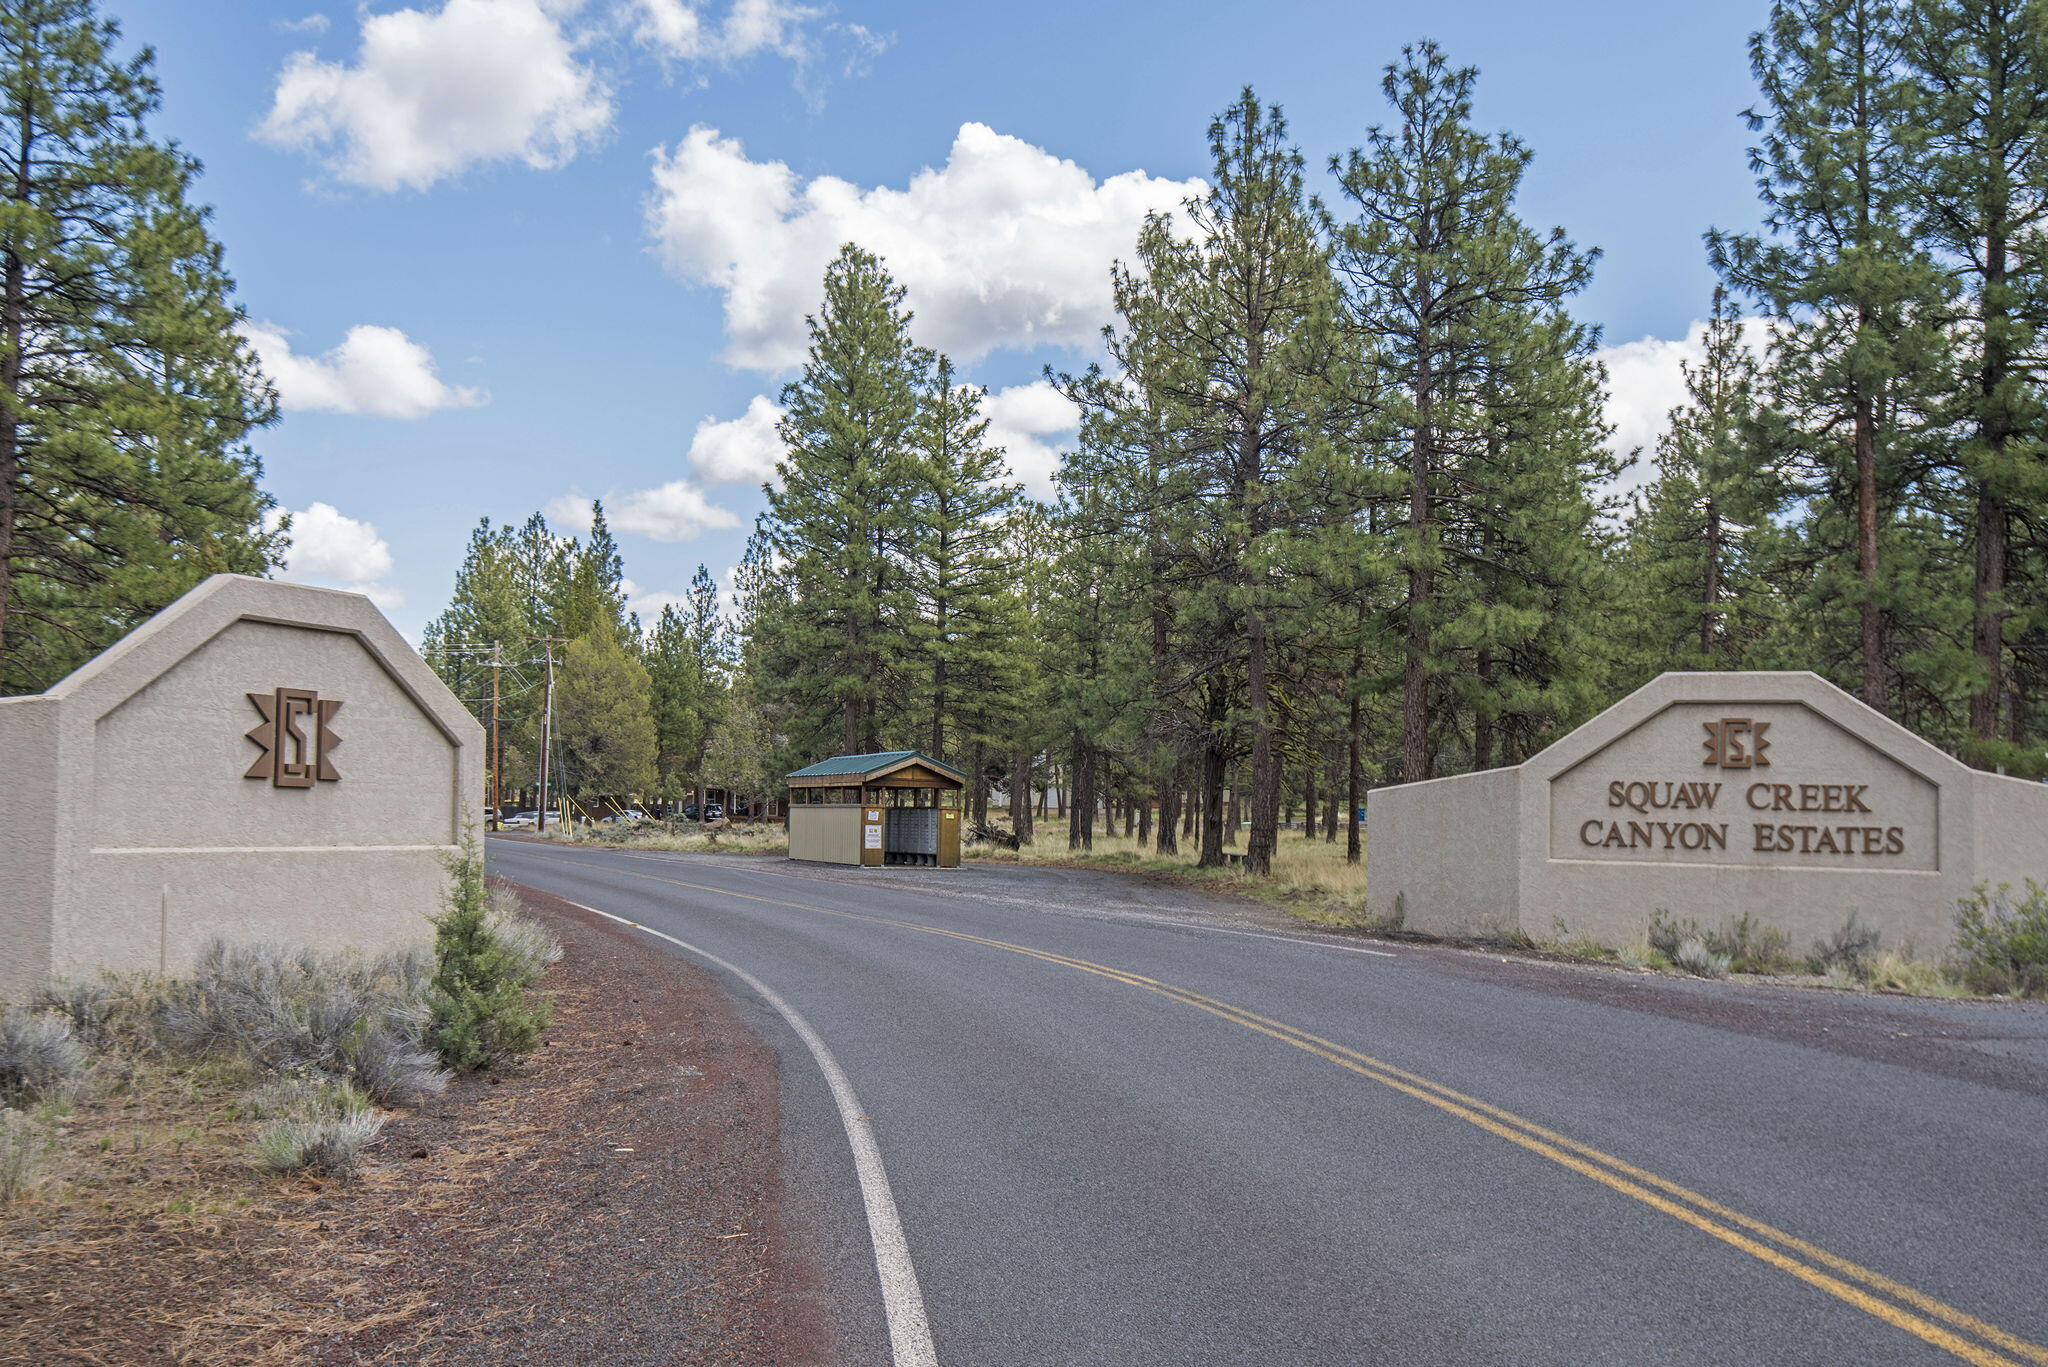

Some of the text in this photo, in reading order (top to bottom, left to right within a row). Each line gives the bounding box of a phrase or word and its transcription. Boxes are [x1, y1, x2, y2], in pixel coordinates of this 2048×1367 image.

[1608, 780, 1873, 815] SQUAW CREEK
[1579, 819, 1906, 855] CANYON ESTATES
